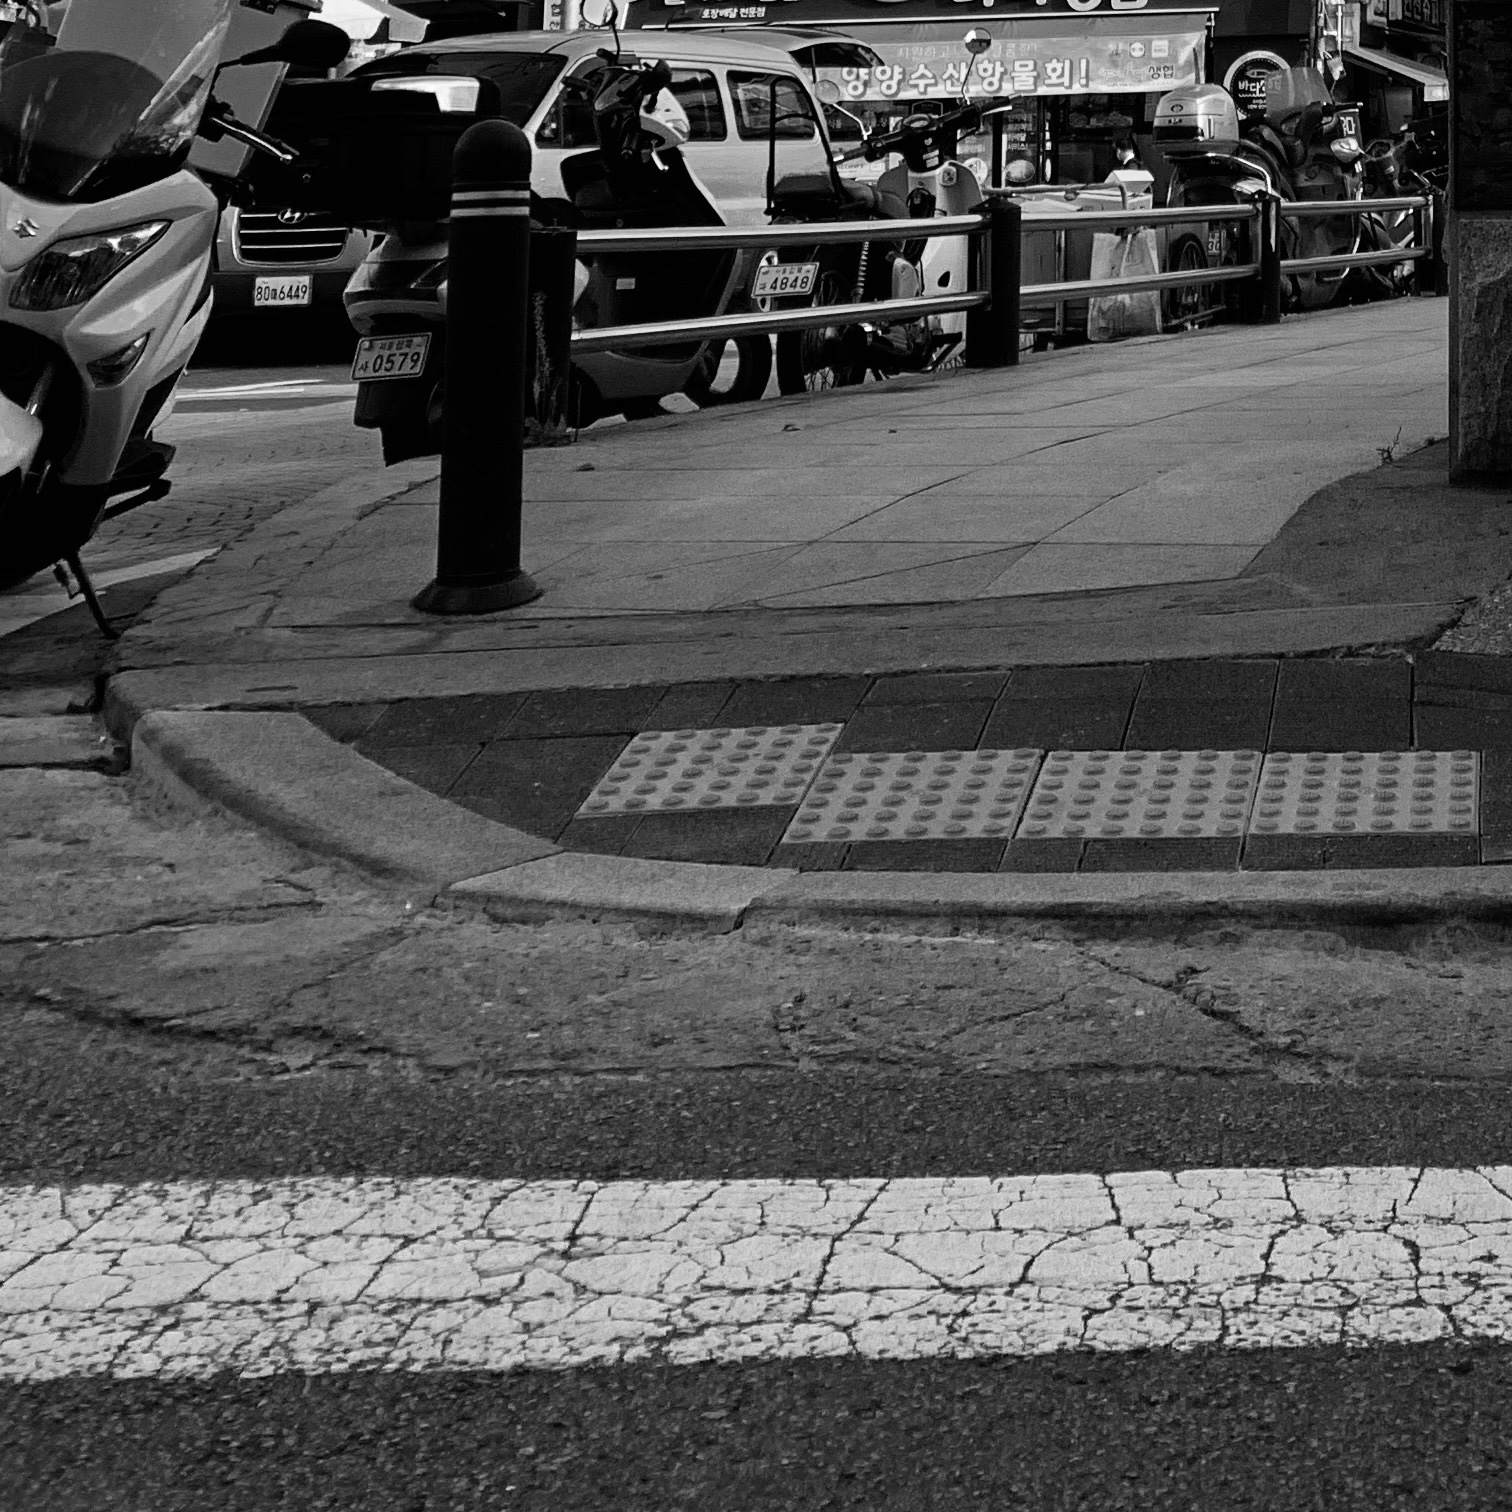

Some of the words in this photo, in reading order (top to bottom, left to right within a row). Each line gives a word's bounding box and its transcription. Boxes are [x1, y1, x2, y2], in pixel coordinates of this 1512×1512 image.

[739, 7, 766, 18] 전문점
[770, 276, 810, 291] 4848
[372, 351, 421, 374] 0579
